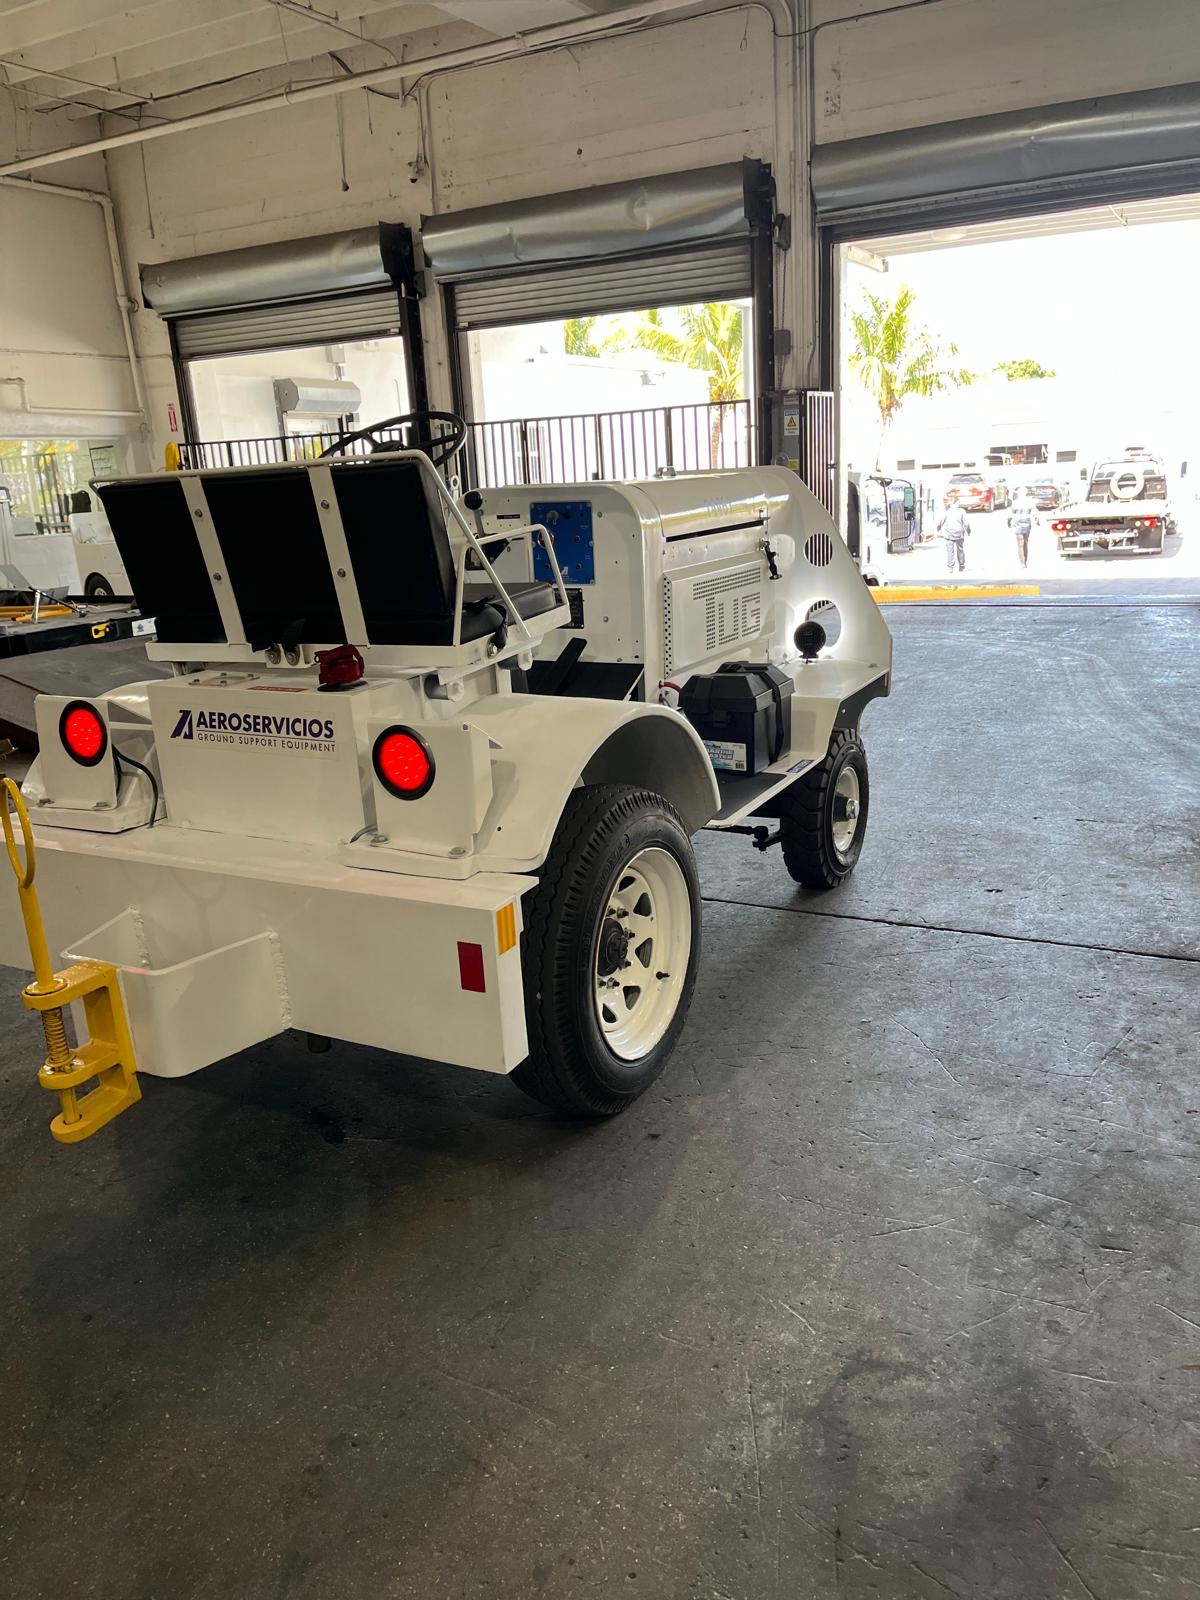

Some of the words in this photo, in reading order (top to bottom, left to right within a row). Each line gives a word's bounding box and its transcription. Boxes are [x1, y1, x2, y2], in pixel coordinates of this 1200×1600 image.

[693, 567, 761, 651] TUG
[196, 710, 334, 739] AEROSERVICIOS
[197, 733, 235, 744] GROUND
[238, 736, 278, 748] SUPPORT
[281, 740, 336, 752] EQUIPMENT
